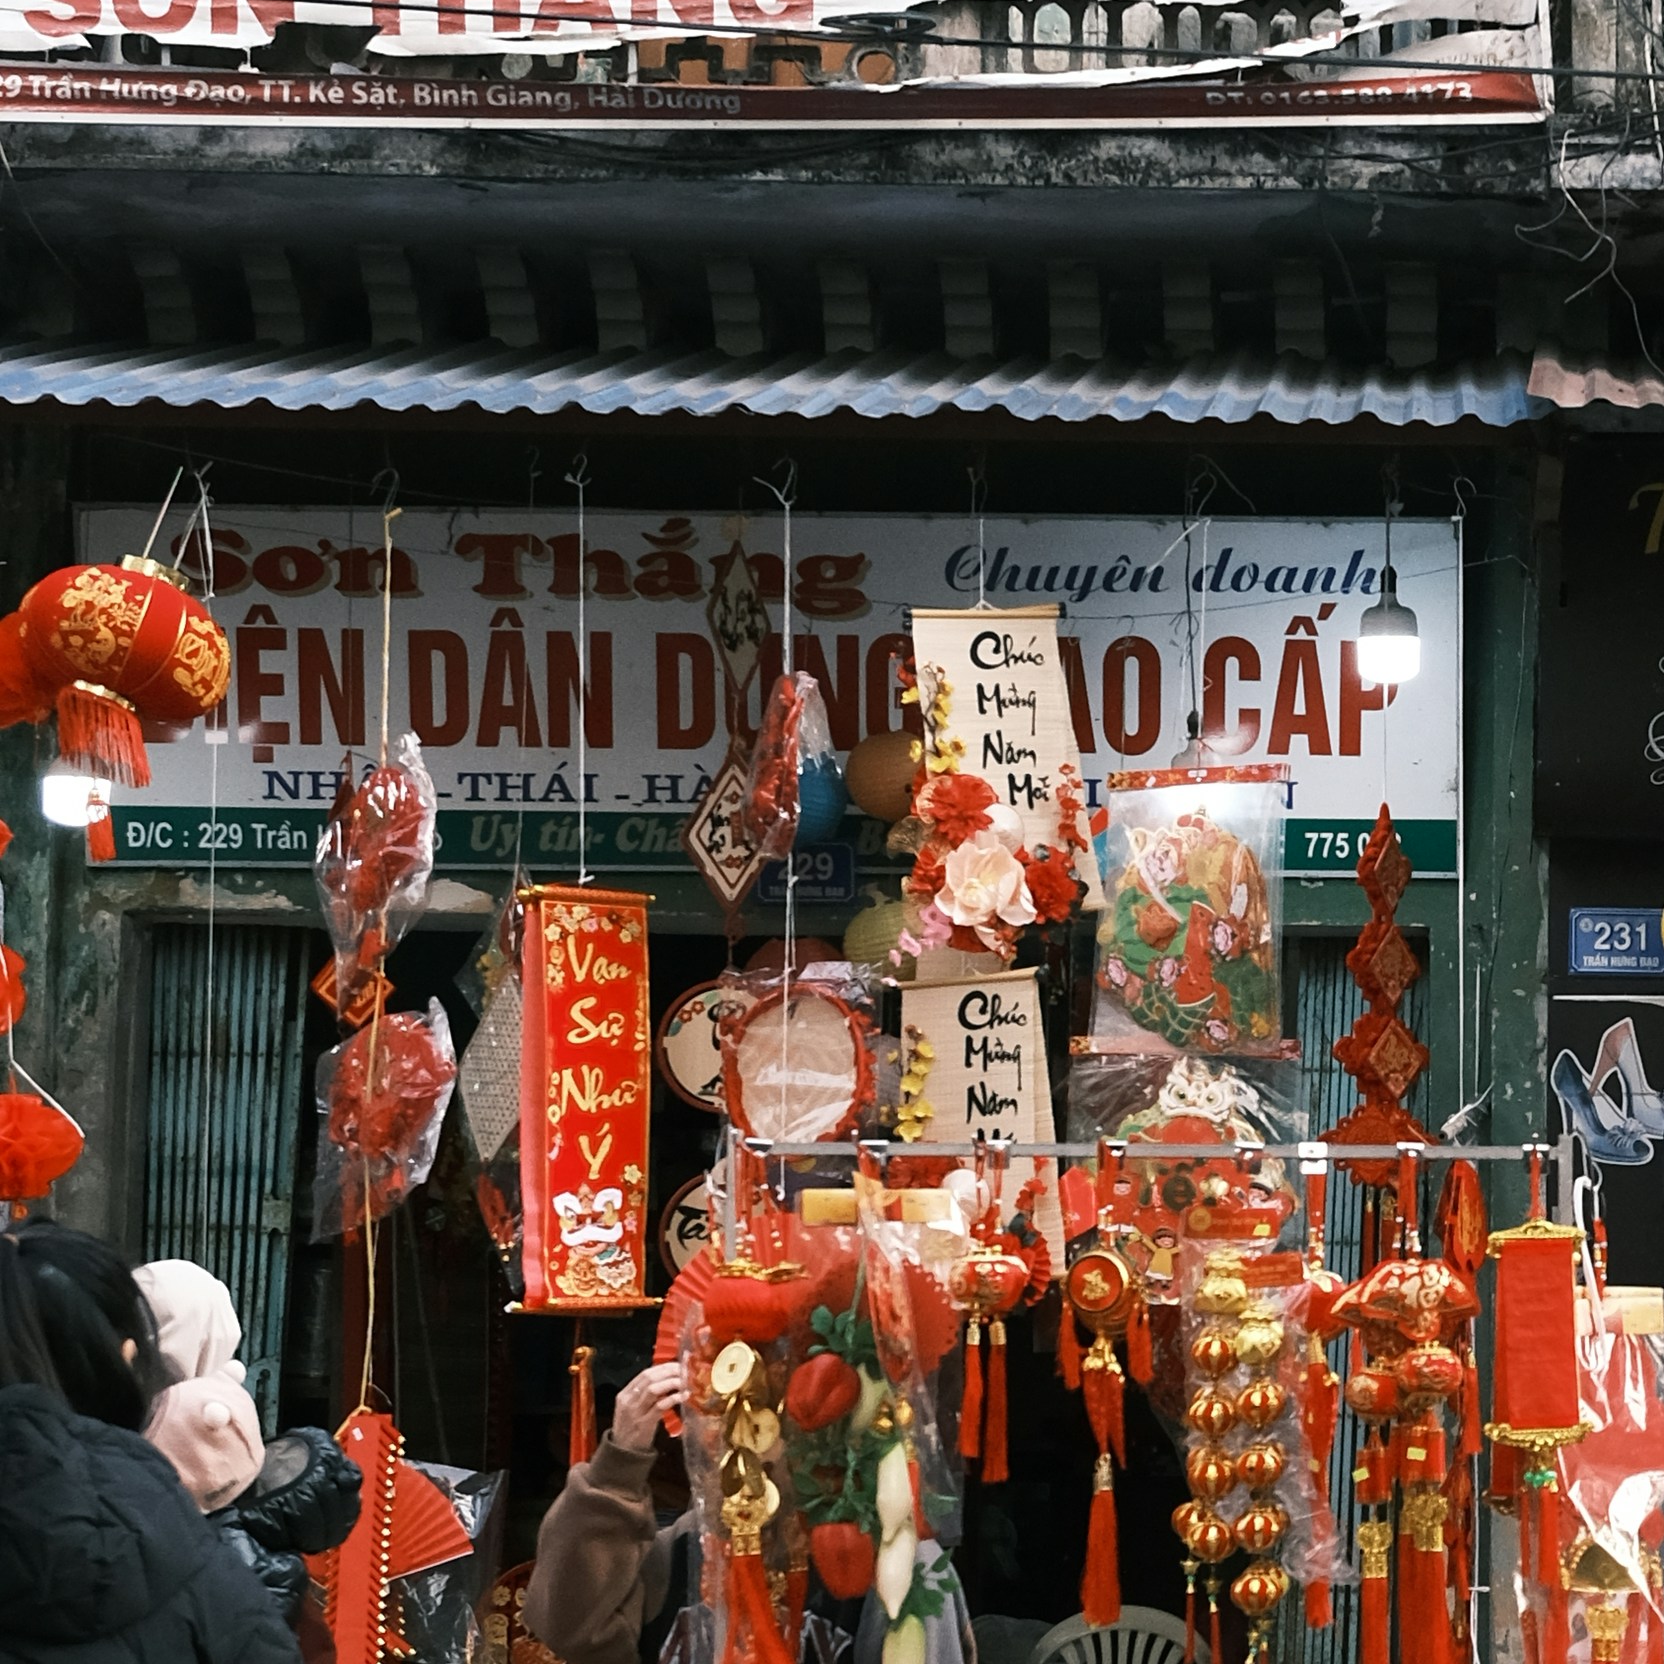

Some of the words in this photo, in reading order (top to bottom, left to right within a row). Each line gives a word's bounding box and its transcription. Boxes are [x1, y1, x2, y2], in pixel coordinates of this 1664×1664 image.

[308, 78, 345, 104] Kẻ
[413, 83, 478, 106] Bình
[171, 530, 421, 599] Sơn
[945, 544, 1170, 602] Chuyên
[1192, 546, 1388, 593] doanh
[970, 631, 1045, 670] Chúc
[410, 608, 613, 749] DÂN
[1203, 602, 1399, 757] CẤP
[976, 683, 1036, 736] Mừng
[982, 730, 1036, 769] Năm
[127, 822, 173, 849] Đ/C
[198, 822, 243, 849] 229
[253, 820, 307, 850] Trần
[1305, 832, 1349, 858] 775
[566, 934, 631, 984] Vạn
[1593, 921, 1647, 951] 231
[566, 996, 625, 1046] Sự
[957, 990, 1027, 1030] Chúc
[561, 1064, 639, 1116] Như
[578, 1122, 613, 1180] Ý
